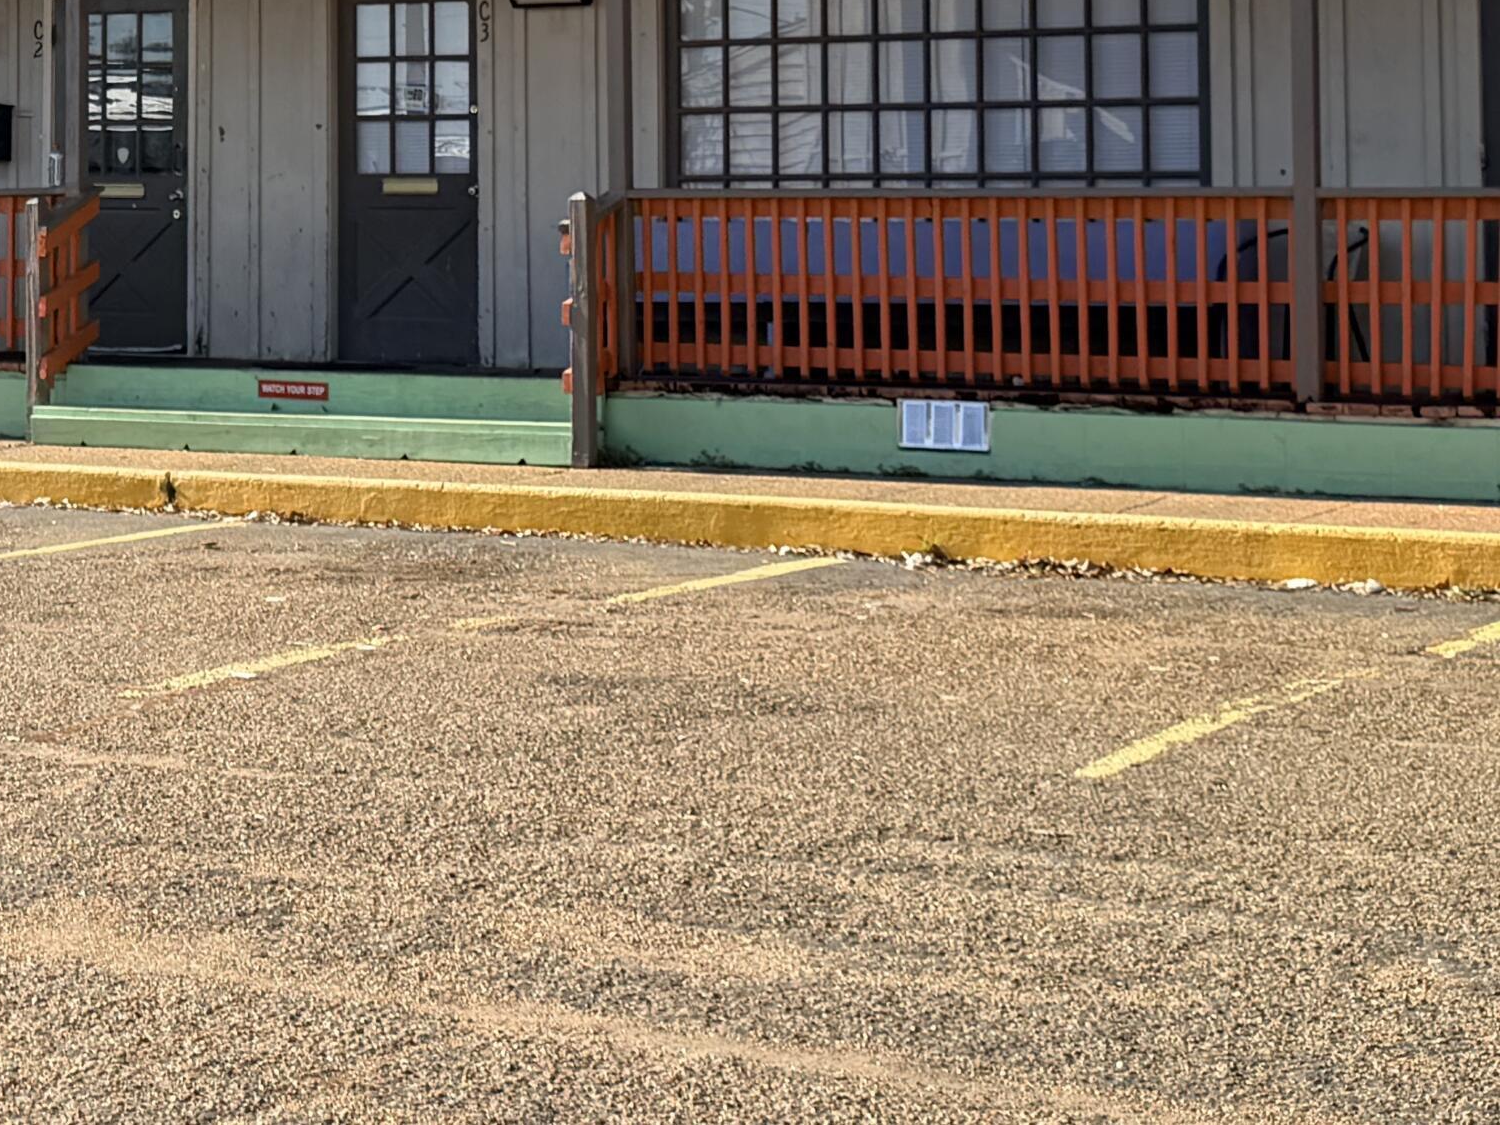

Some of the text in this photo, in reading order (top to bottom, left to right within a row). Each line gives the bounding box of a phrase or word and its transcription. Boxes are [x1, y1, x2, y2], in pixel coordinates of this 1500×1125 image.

[261, 383, 325, 396] WATCH YOUR STEP
